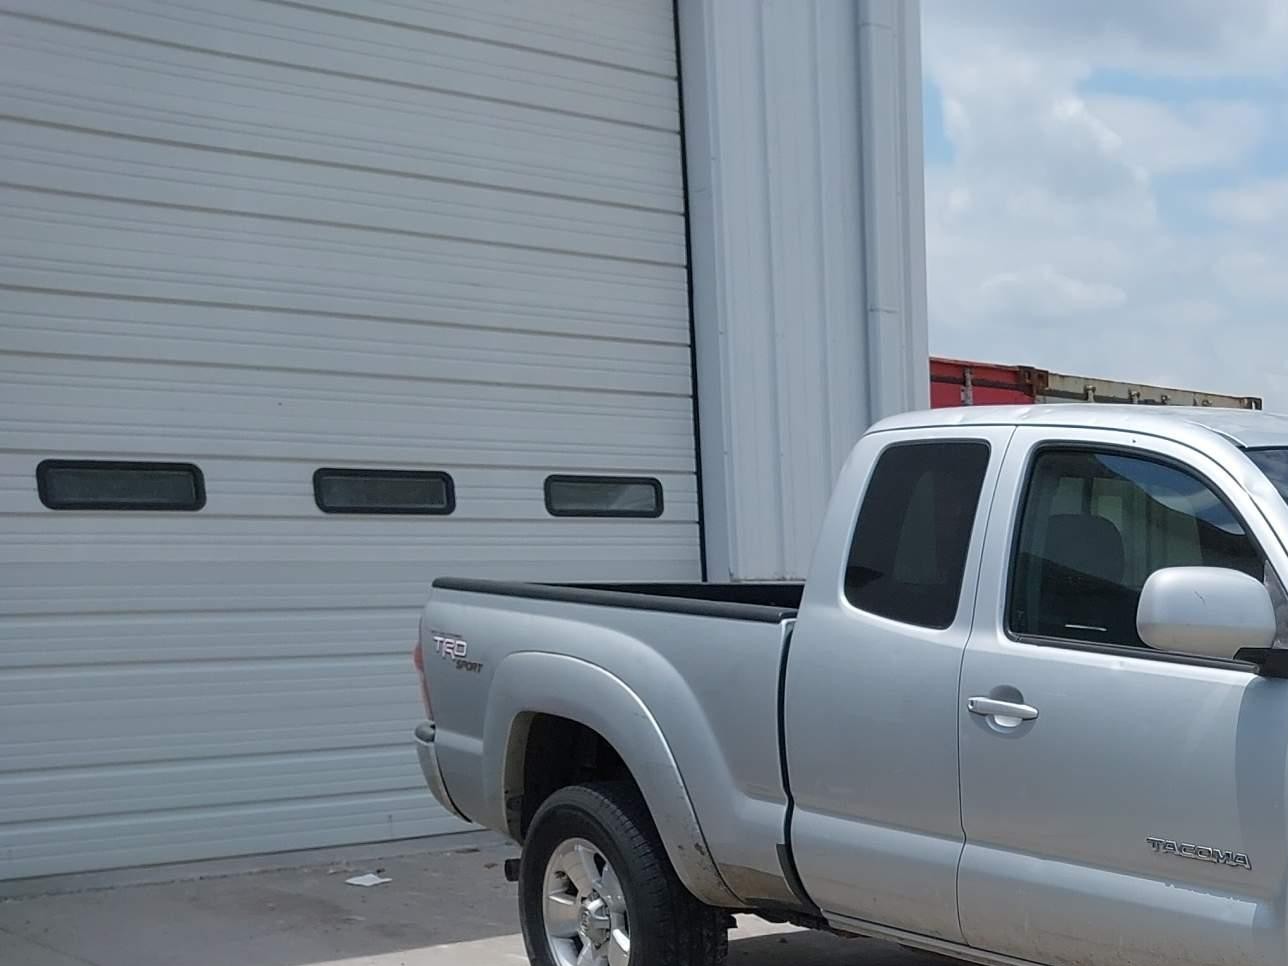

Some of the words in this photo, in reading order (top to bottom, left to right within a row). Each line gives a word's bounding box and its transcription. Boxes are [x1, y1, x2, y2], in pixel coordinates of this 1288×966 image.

[432, 636, 468, 660] TRD
[455, 659, 484, 674] SPORT
[1146, 836, 1253, 871] TACOMA
